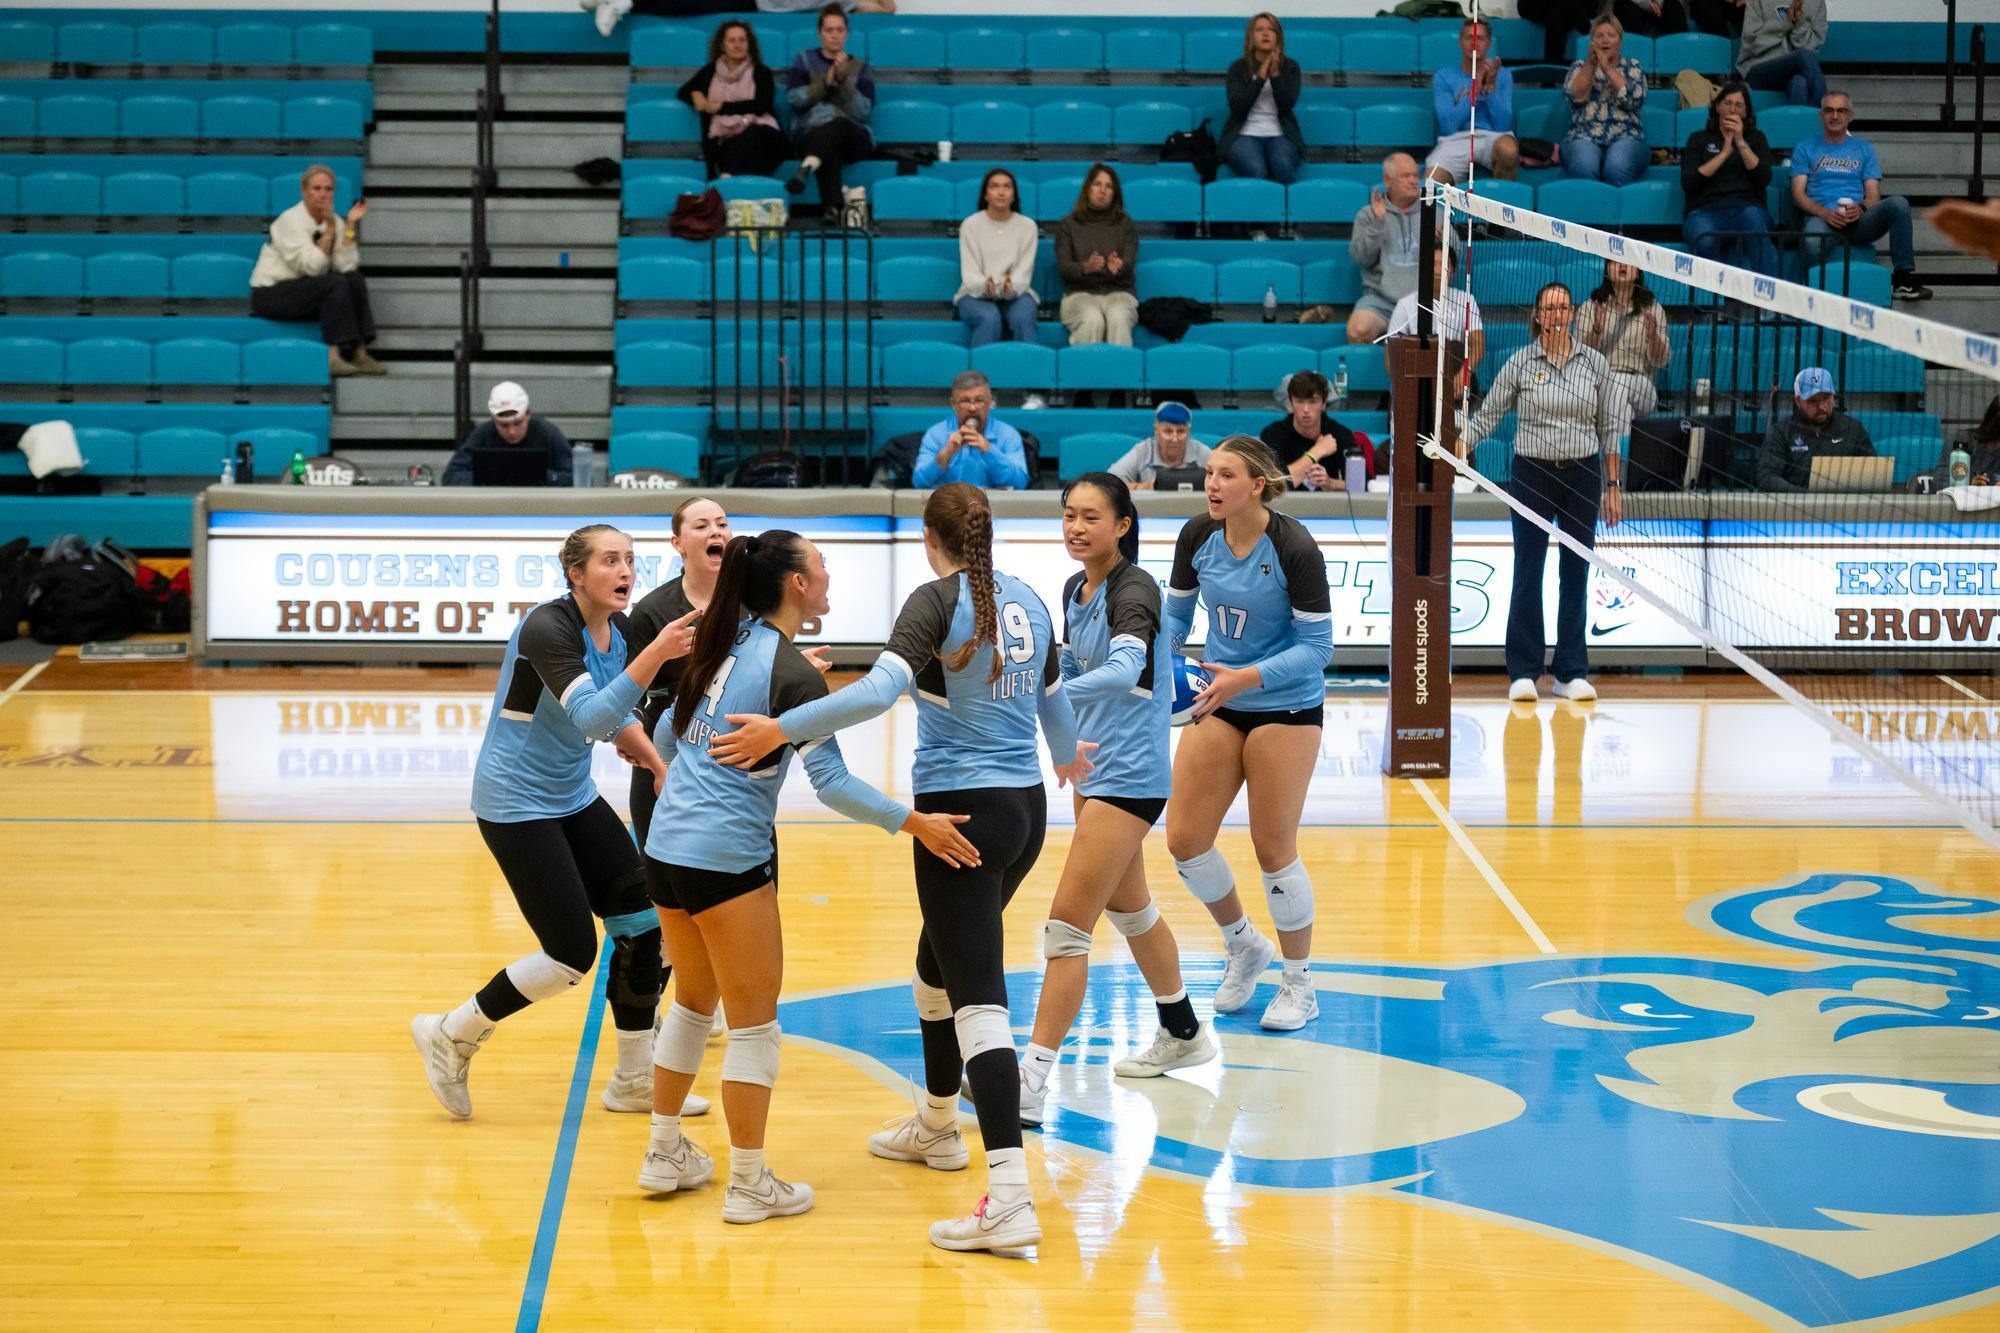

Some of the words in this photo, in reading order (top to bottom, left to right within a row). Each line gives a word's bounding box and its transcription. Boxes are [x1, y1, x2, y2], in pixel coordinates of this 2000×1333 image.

[304, 463, 354, 486] ufts
[275, 553, 499, 587] COUSENS
[277, 600, 420, 633] HOME
[436, 601, 494, 633] OF
[1216, 604, 1248, 640] 17
[1414, 599, 1429, 646] sports
[1835, 608, 2000, 641] BROW
[703, 654, 738, 718] 4
[1414, 648, 1429, 705] imports
